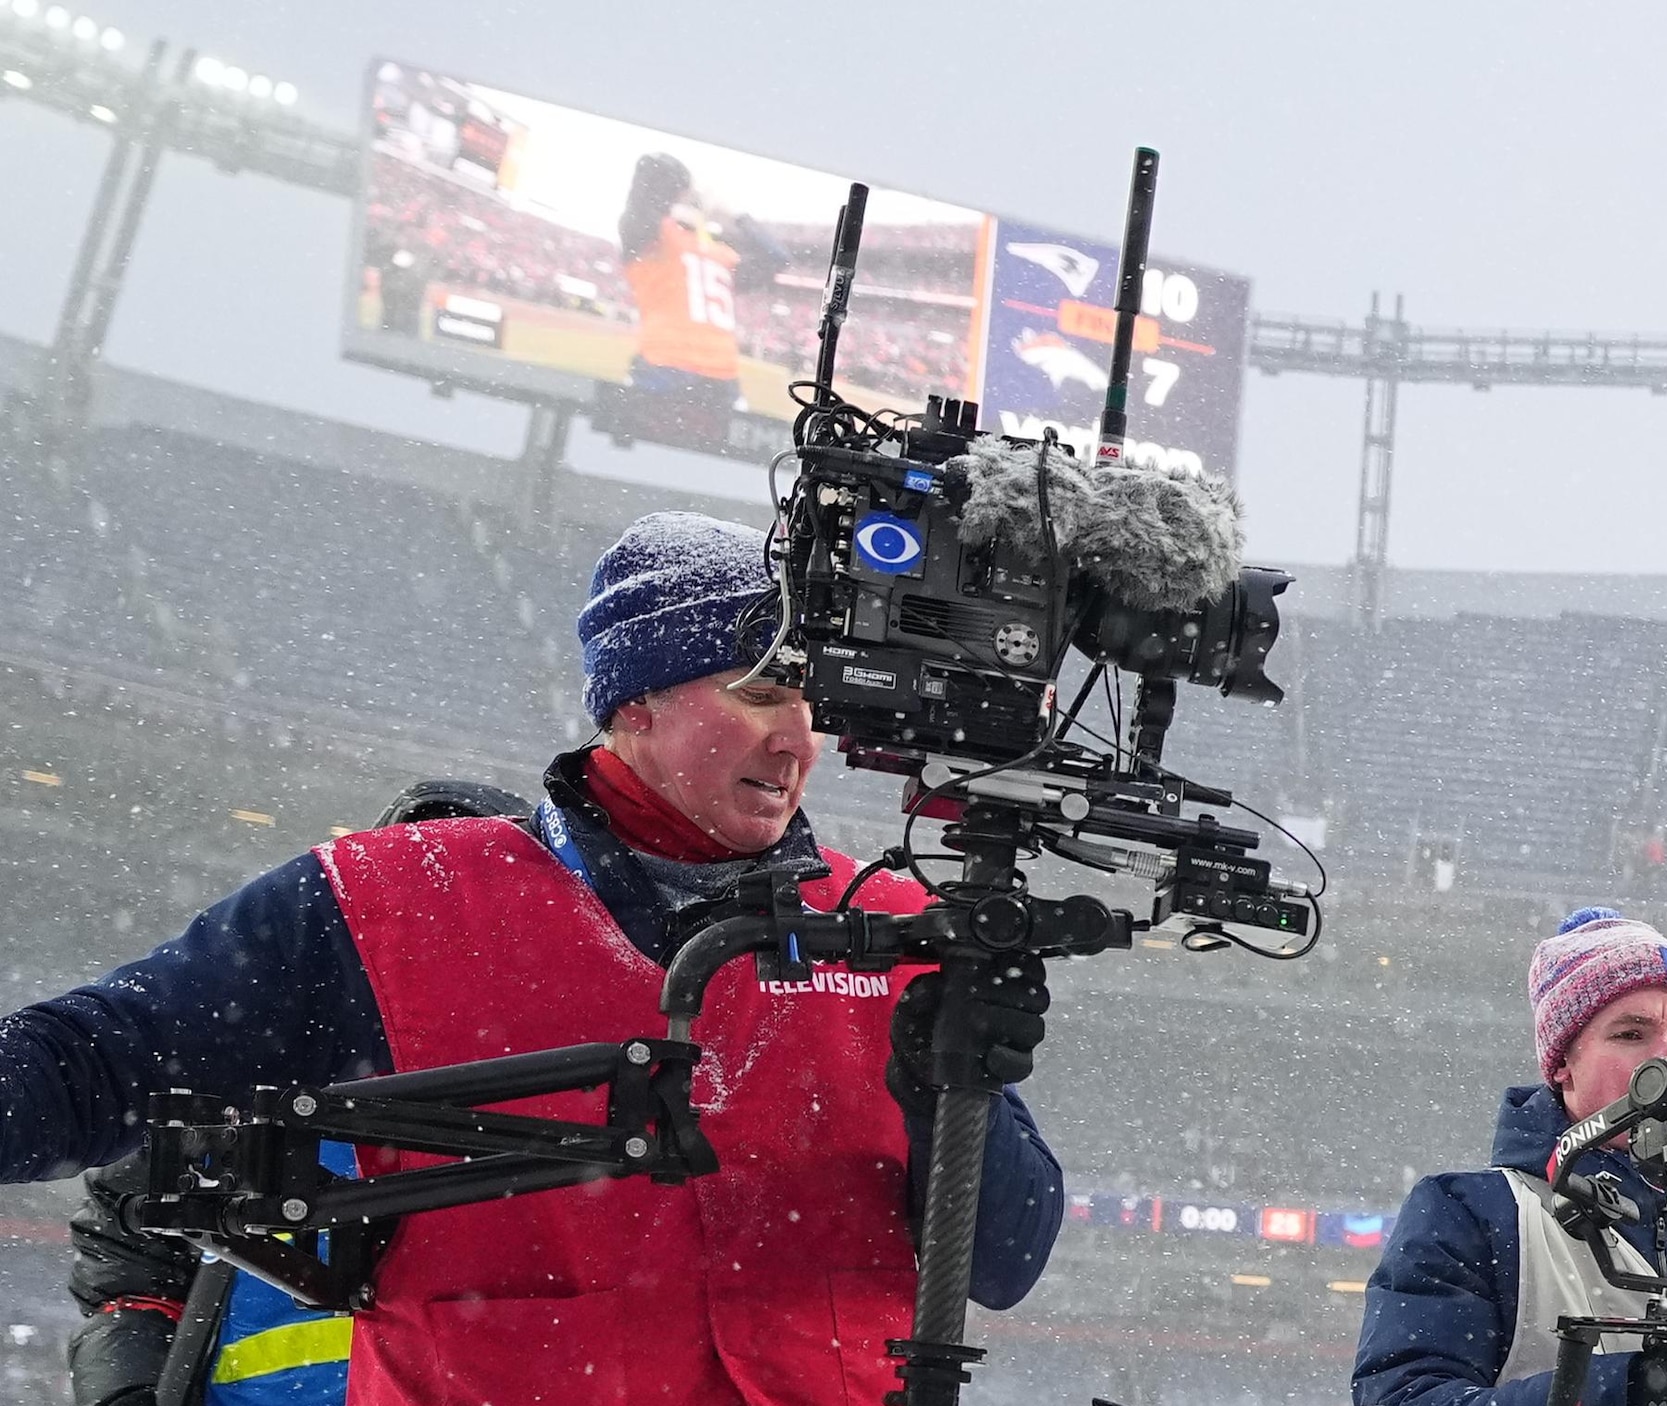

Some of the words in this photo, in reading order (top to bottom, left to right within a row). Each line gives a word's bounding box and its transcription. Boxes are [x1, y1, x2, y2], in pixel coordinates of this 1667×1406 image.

[680, 252, 736, 331] 15
[1141, 268, 1199, 324] 10
[1141, 358, 1181, 407] 7
[1555, 1114, 1607, 1167] RONIN
[1180, 1204, 1237, 1233] 0:00
